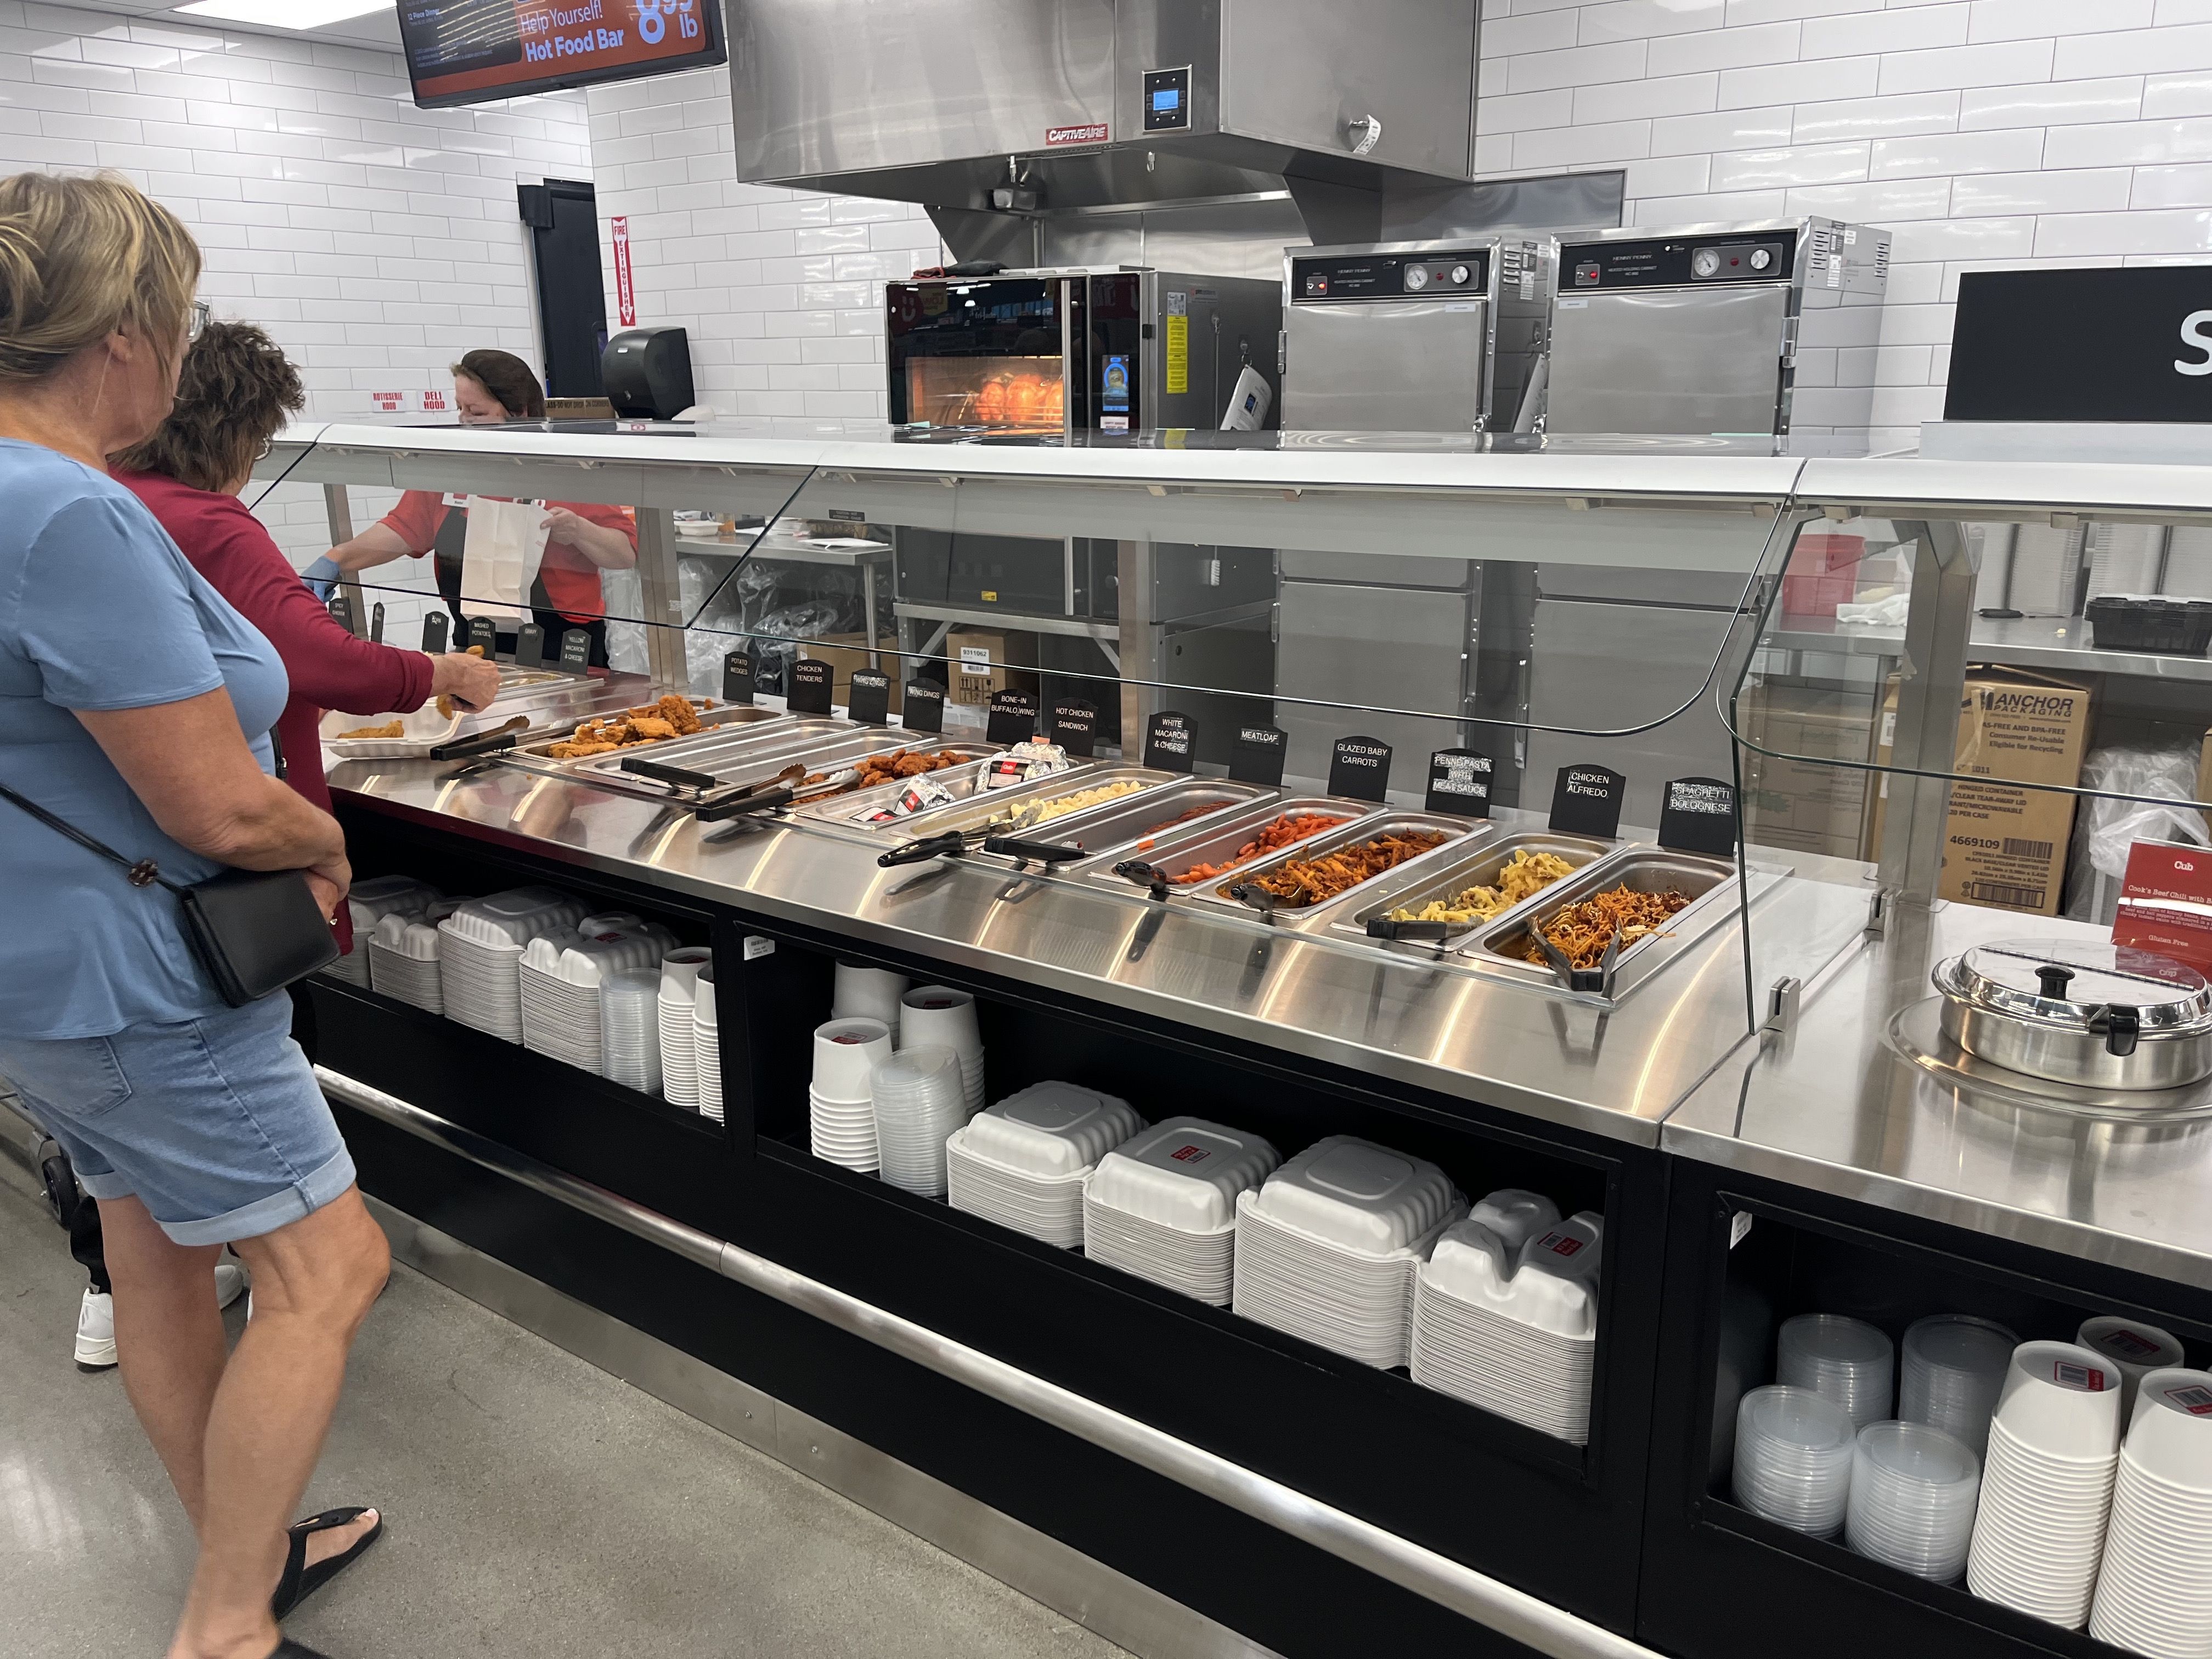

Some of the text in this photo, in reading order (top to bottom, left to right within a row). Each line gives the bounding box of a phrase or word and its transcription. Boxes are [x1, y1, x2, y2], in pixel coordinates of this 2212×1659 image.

[413, 11, 425, 19] Piece
[521, 1, 603, 35] Help Yourself!
[679, 13, 698, 38] lb
[525, 27, 624, 63] Hot Food Bar
[614, 225, 626, 236] FIRE
[619, 240, 630, 318] EXTINGUISHER
[2174, 309, 2212, 376] S
[373, 392, 403, 401] ROTISSERIE
[425, 391, 442, 400] DELI
[382, 402, 396, 410] HOOD
[424, 400, 445, 409] HOOD
[731, 657, 748, 666] POTATO
[730, 667, 748, 675] WEDGES
[796, 674, 823, 682] TENDERS
[909, 688, 940, 699] WING DINGS
[1001, 695, 1027, 704] BONE-IN
[1995, 693, 2074, 710] ANCHOR
[991, 704, 1035, 716] BUFFALO WING
[1056, 707, 1094, 719] HOT CHICKEN
[1993, 704, 2072, 717] PACKAGING
[1058, 720, 1088, 731] SANDWICH
[1162, 718, 1182, 728] WHITE
[2012, 723, 2029, 732] AND
[2032, 726, 2067, 735] BPA-FREE
[1154, 729, 1188, 740] MACARONI
[1241, 731, 1278, 743] MEATLOAF
[1989, 731, 2064, 744] Consumer Re-Usable
[1160, 741, 1187, 752] CHEESE
[1338, 743, 1387, 757] GLAZED BABY
[1989, 740, 2015, 749] Eligible
[2029, 744, 2063, 754] Recycling
[1342, 755, 1378, 768] CARROTS
[1434, 756, 1491, 771] PENNE PASTA
[1451, 769, 1471, 780] WITH
[1570, 771, 1610, 785] CHICKEN
[1433, 780, 1487, 795] MEAT SAUCE
[1567, 784, 1608, 798] ALFREDO
[1674, 786, 1730, 800] SPAGHETTI
[1670, 798, 1732, 813] BOLOGNESE
[1950, 835, 2000, 849] 4669109
[2174, 860, 2193, 871] Cub
[2128, 884, 2151, 895] Cook's
[2153, 888, 2170, 898] Beef
[2188, 895, 2204, 904] with
[2148, 934, 2188, 947] Gluten Free
